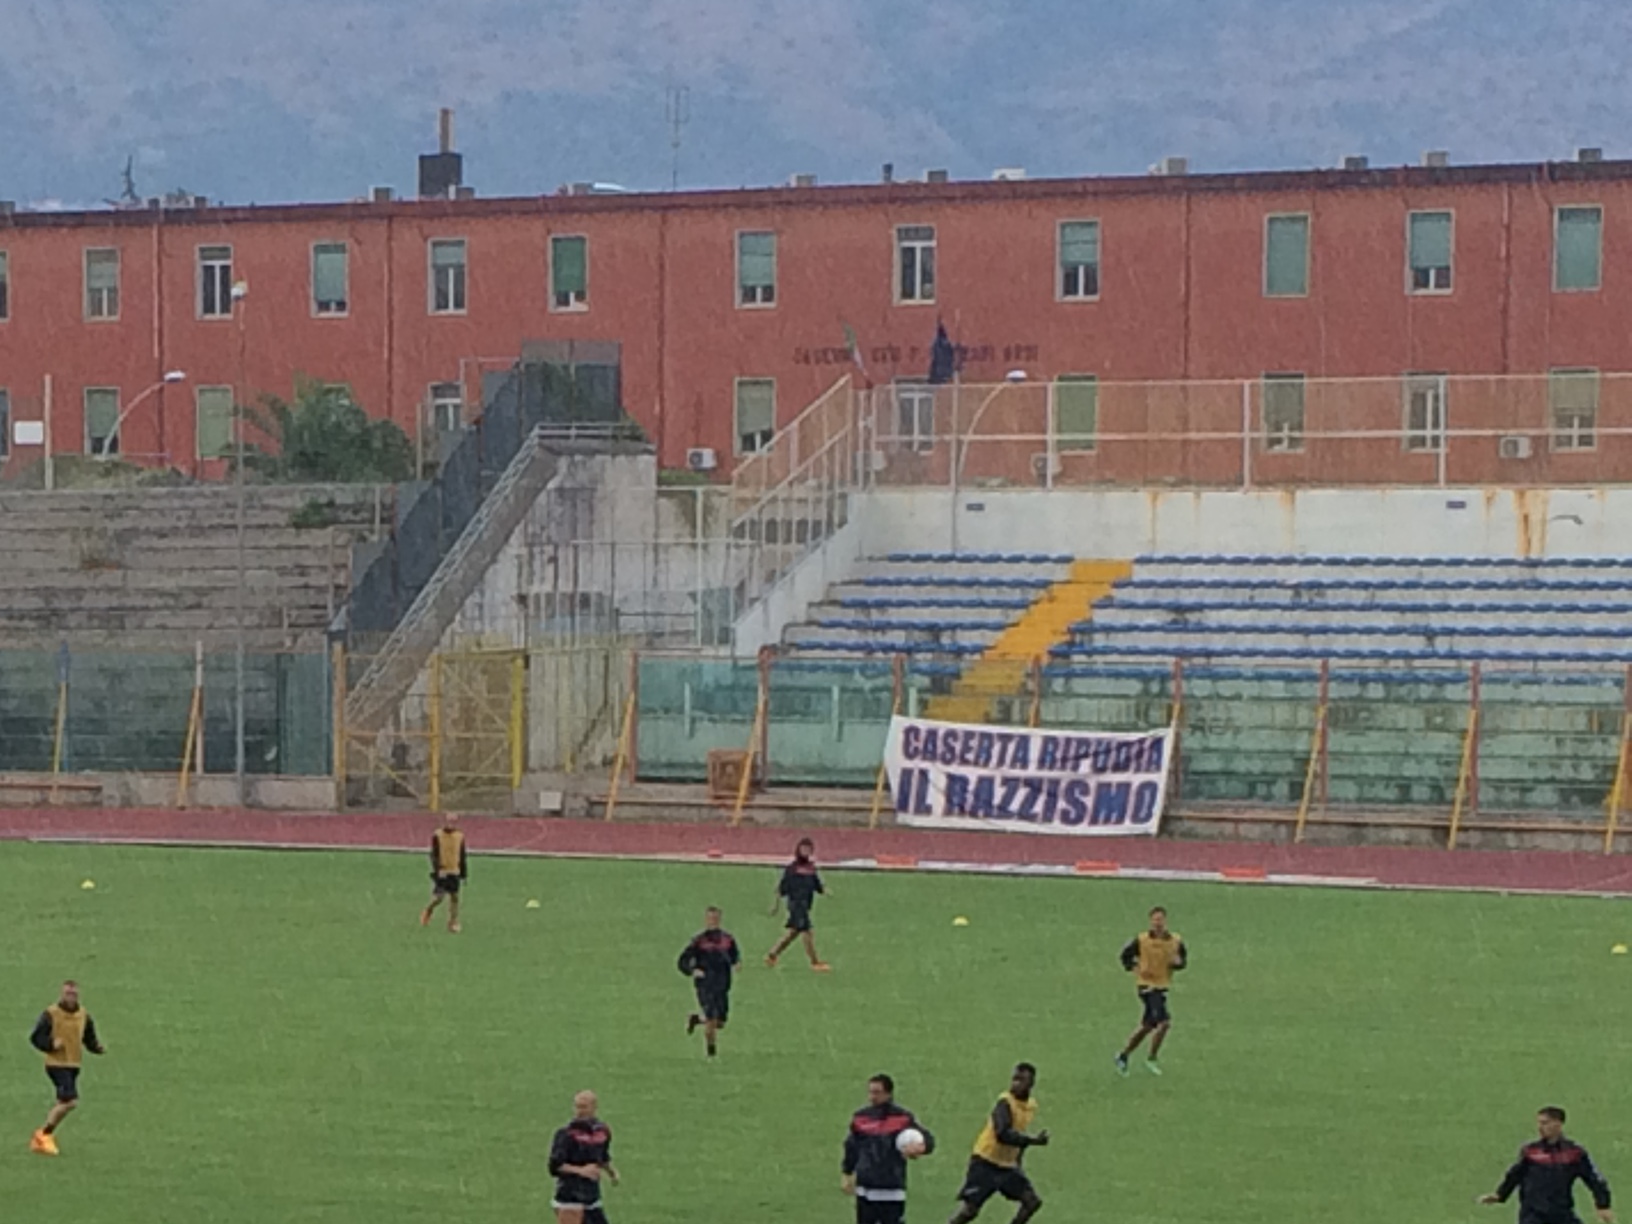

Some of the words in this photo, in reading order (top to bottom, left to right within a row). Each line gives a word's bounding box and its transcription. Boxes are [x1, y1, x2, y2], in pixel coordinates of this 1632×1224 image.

[902, 725, 1030, 770] CASERTA
[1036, 735, 1165, 773] RIPUDIA
[896, 767, 932, 815] IL
[942, 771, 1159, 826] RAZZISMO
